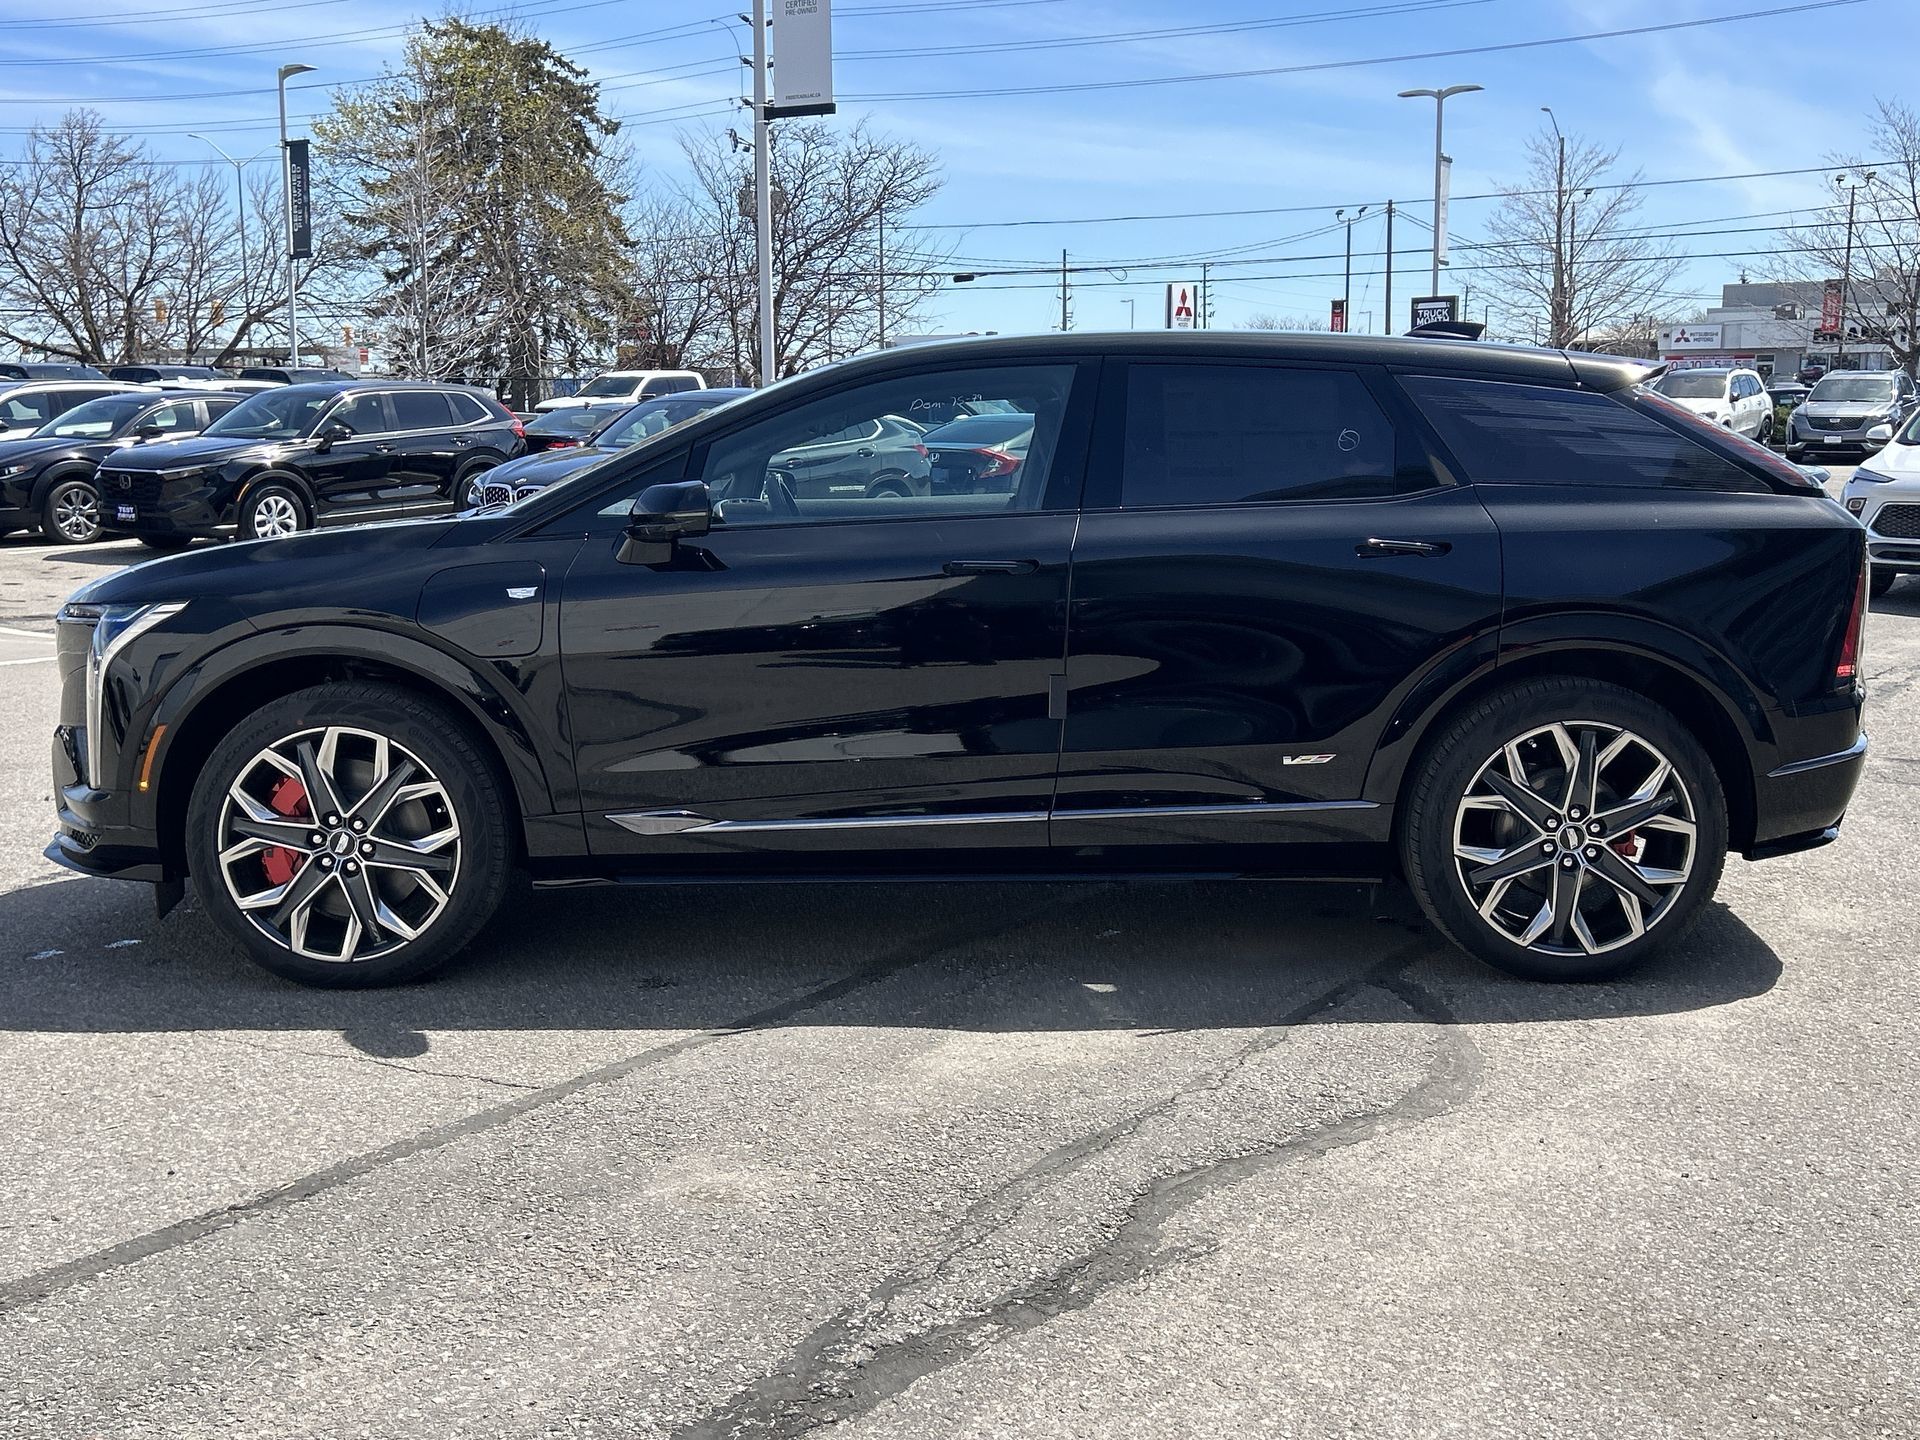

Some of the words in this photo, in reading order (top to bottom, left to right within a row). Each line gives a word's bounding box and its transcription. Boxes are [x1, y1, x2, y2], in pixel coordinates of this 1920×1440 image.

[785, 0, 817, 9] CERTIFIED
[785, 6, 818, 16] PRE-OWNED
[1417, 308, 1449, 318] TRUCK
